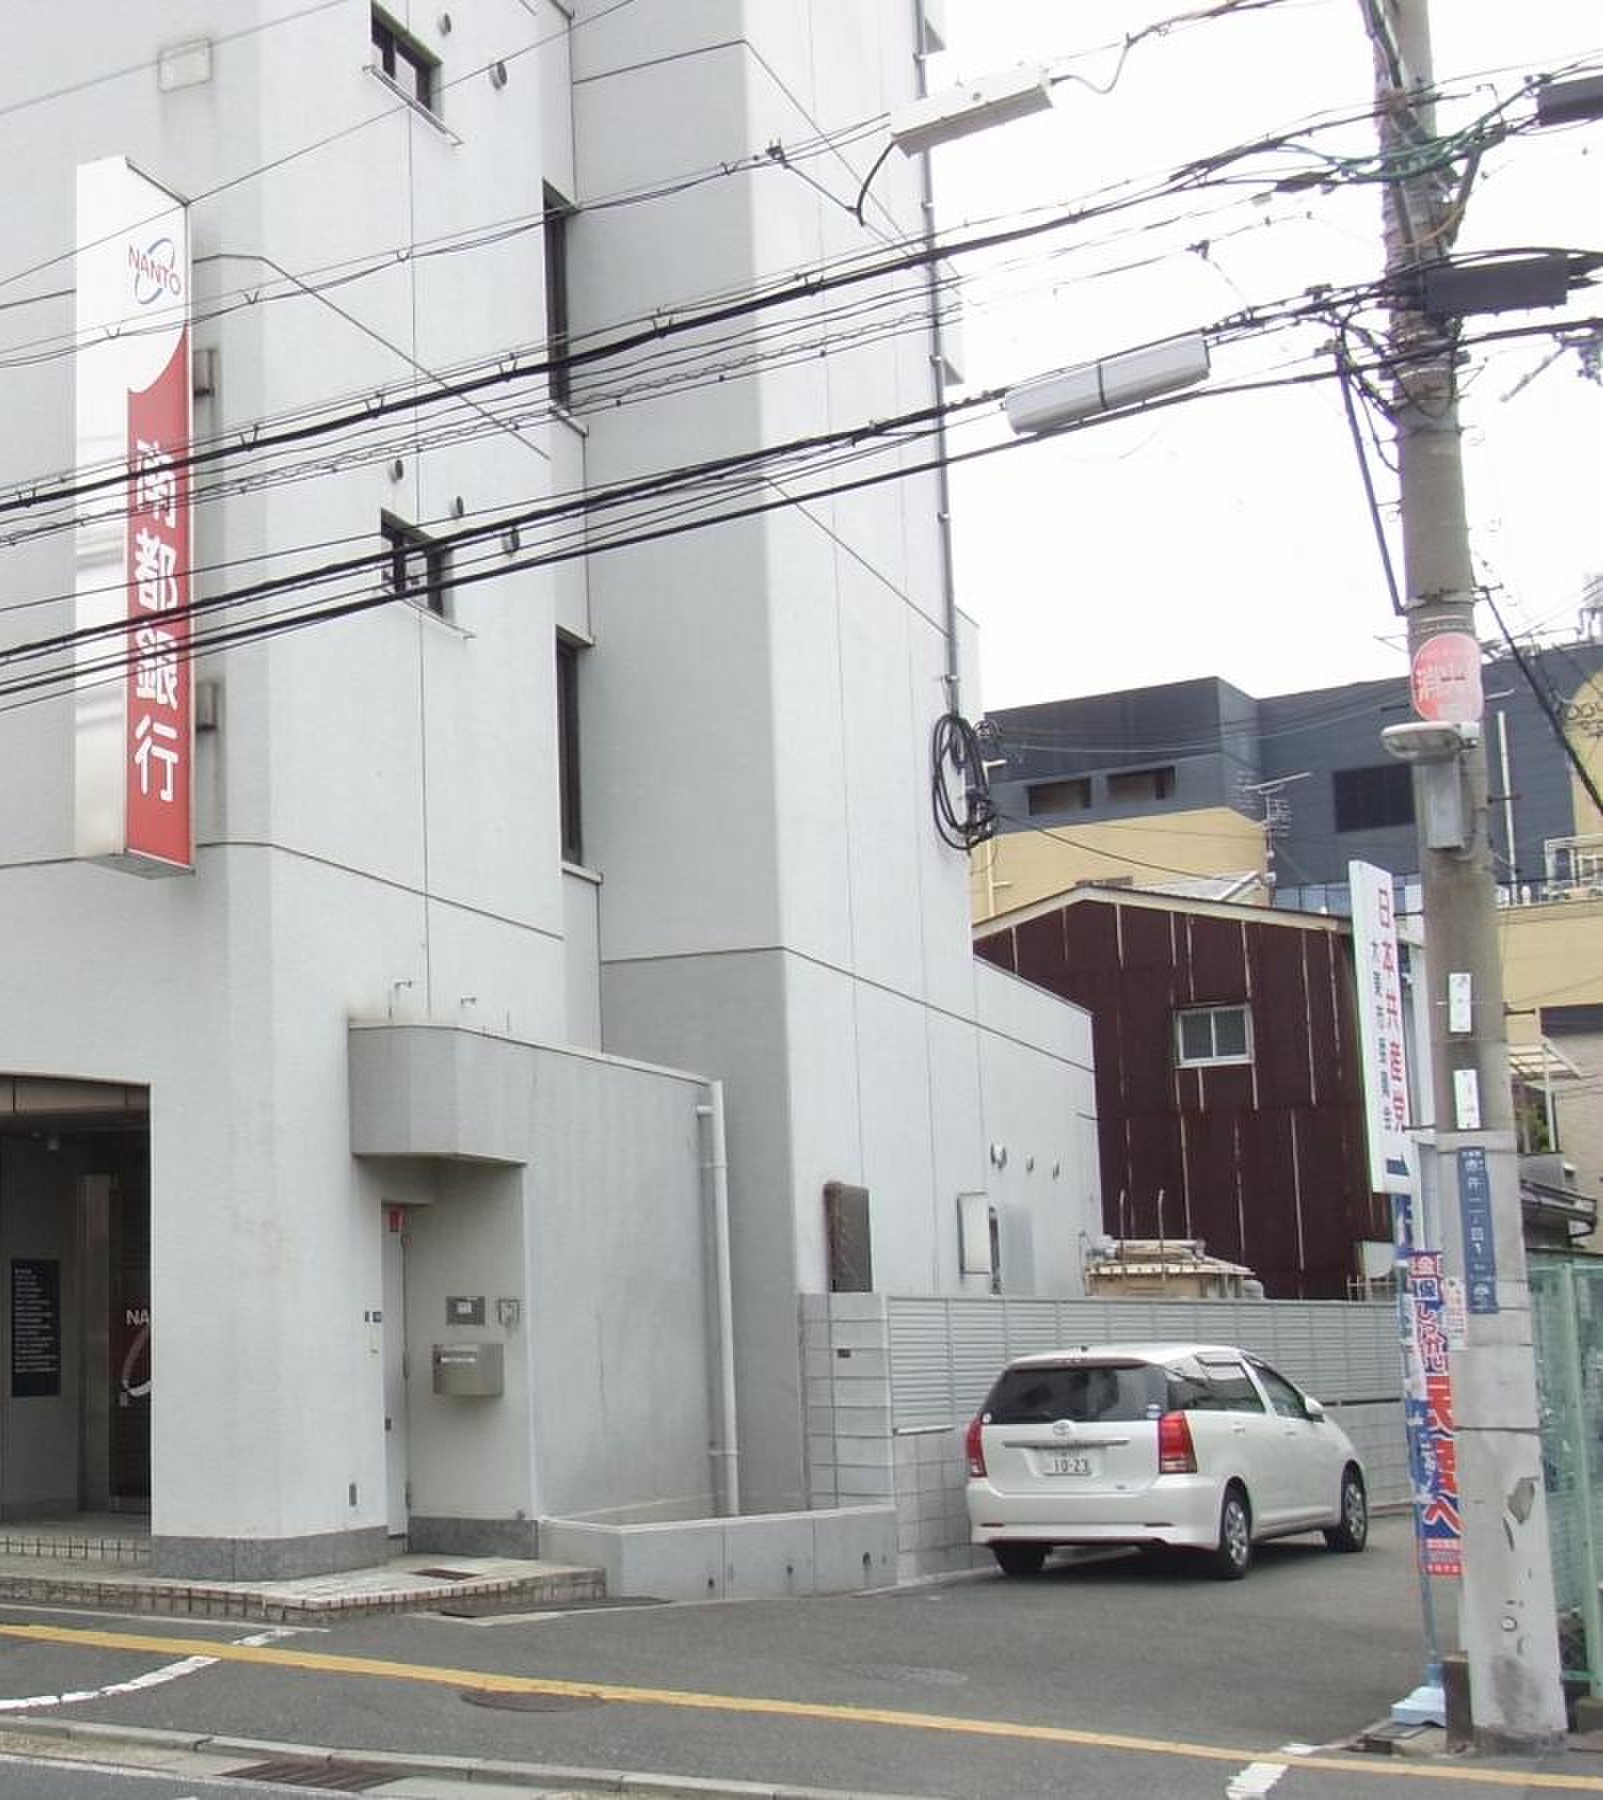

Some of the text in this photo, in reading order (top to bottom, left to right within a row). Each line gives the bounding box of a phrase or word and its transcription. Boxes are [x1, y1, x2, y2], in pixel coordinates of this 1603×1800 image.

[128, 243, 181, 296] NANTO
[135, 439, 179, 802] 南都銀行
